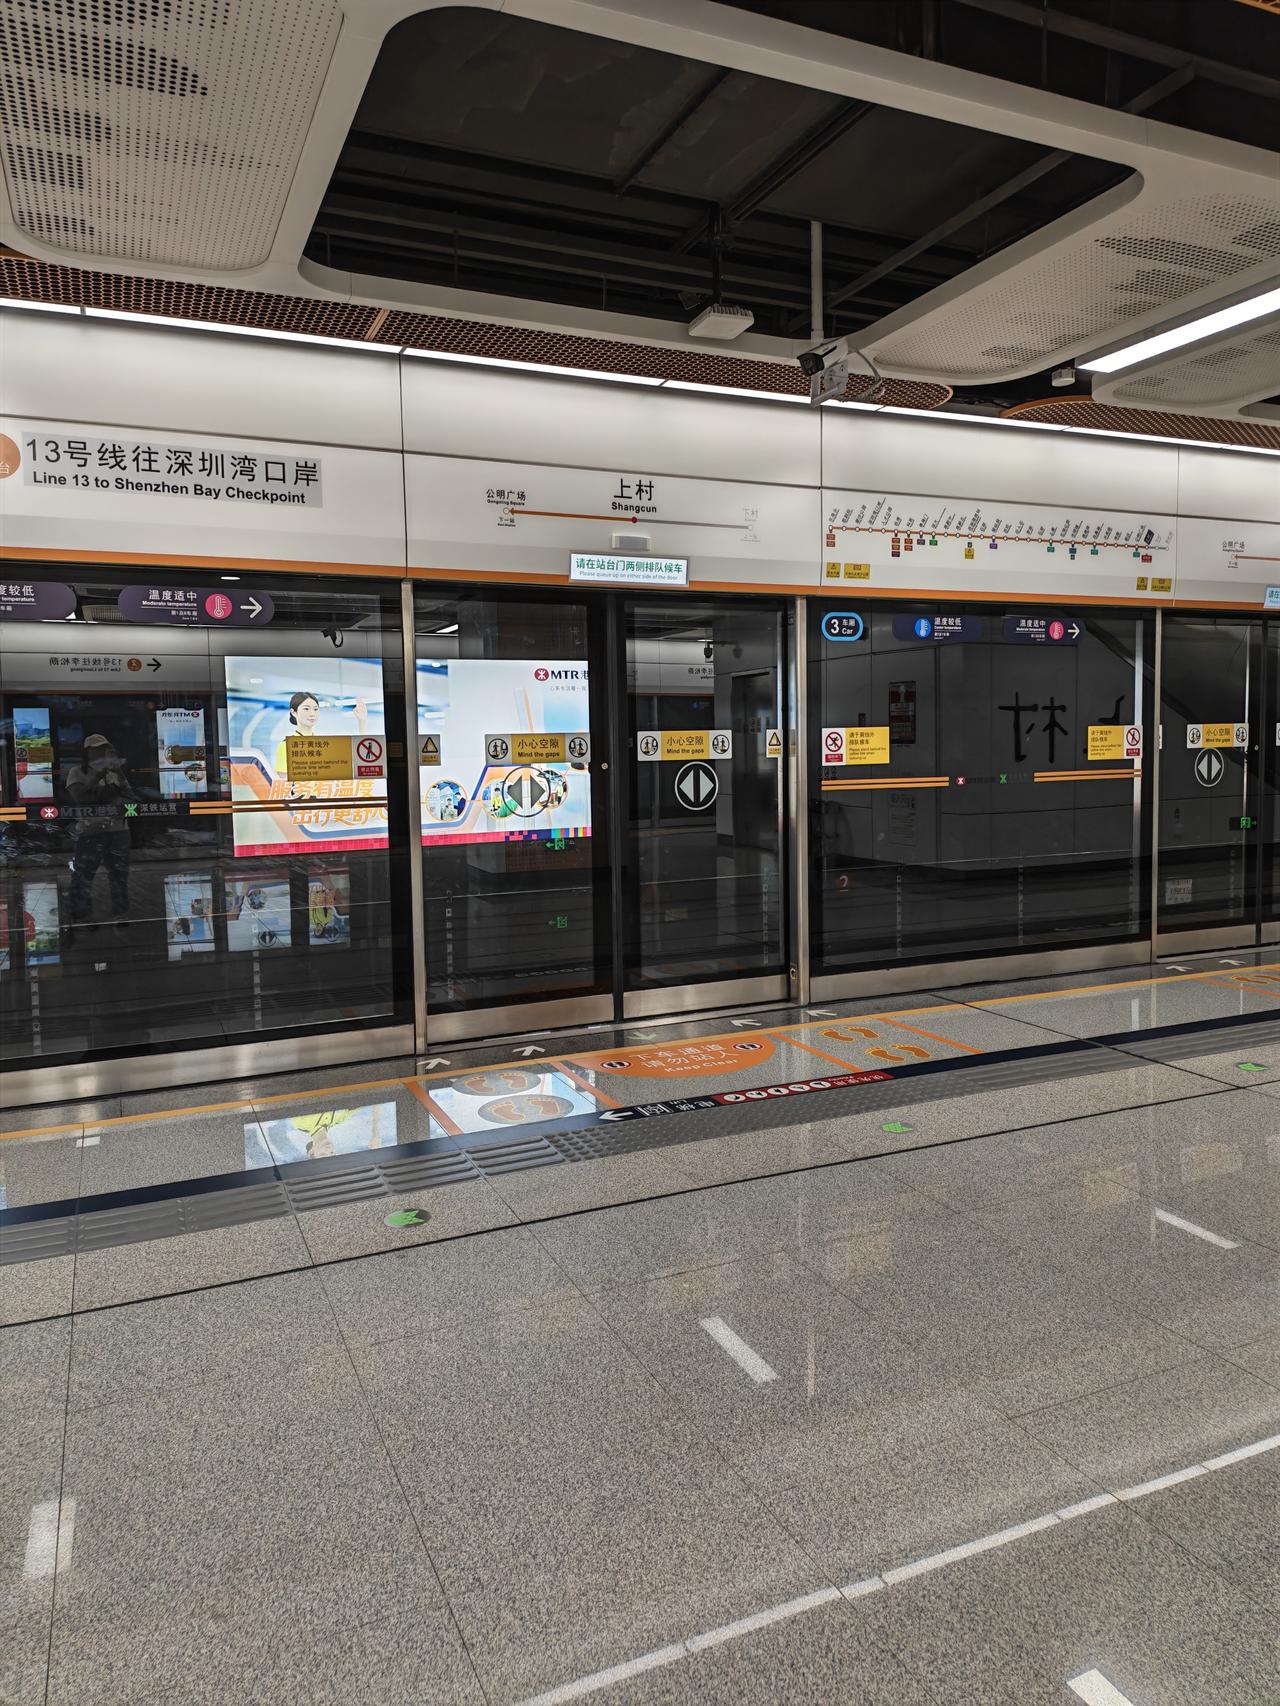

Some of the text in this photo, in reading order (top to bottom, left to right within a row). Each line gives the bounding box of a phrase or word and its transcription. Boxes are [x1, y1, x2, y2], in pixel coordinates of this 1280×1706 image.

[26, 438, 319, 487] 13号线往深圳湾口岸
[33, 471, 306, 505] Line 13 to Shenzhen Bay Checkpoint
[613, 478, 655, 501] 上村
[486, 489, 526, 502] 公明广场
[611, 501, 657, 513] Shangcun
[576, 558, 683, 574] 请在站台门两侧排队候车
[149, 589, 197, 601] 温度适中
[830, 618, 839, 634] 3
[842, 619, 855, 627] 车厢
[934, 617, 962, 626] 温度较低
[1019, 619, 1046, 628] 温度适中
[842, 627, 853, 635] Car
[1206, 728, 1230, 737] 小心空隙
[291, 740, 329, 749] 请于黄线外
[517, 739, 560, 750] 小心空隙
[666, 736, 704, 746] 小心空隙
[291, 750, 322, 758] 排队候车
[270, 780, 374, 799] 服务有温度
[140, 803, 177, 812] 深铁运营
[629, 1043, 727, 1060] 下车通道
[640, 1050, 738, 1068] 请勿站人
[664, 1058, 738, 1073] Keep Clear
